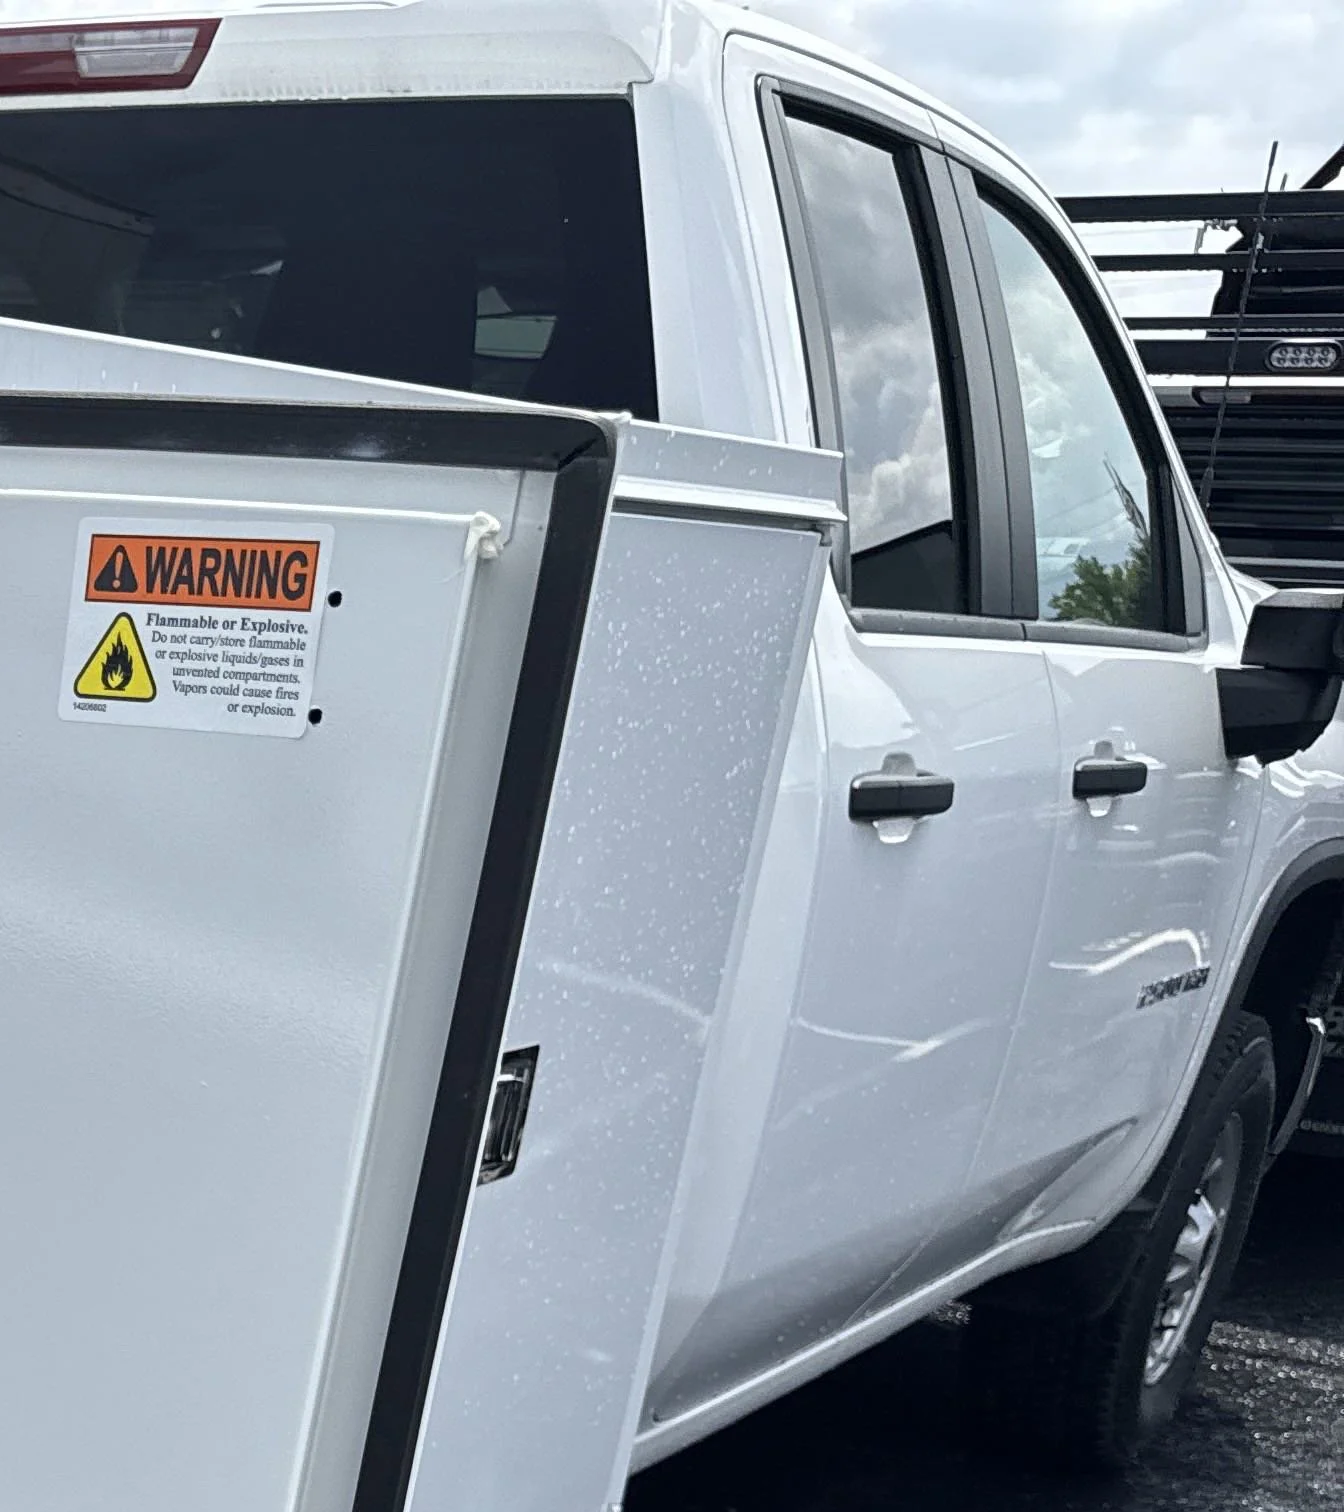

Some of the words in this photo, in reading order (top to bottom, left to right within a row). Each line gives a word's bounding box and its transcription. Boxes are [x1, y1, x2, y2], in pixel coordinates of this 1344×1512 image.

[145, 546, 309, 601] WARNING
[146, 612, 219, 630] Flammable
[222, 618, 237, 631] or
[240, 617, 309, 635] Explosive.
[151, 630, 168, 643] Do
[170, 632, 187, 644] not
[189, 634, 246, 648] carry/store
[249, 635, 307, 651] flammable
[155, 650, 168, 660] or
[168, 649, 219, 664] explosive
[221, 650, 290, 668] liquids/gases
[293, 654, 305, 668] in
[172, 666, 220, 679] unvented
[222, 670, 301, 684] compartments.
[172, 680, 207, 696] Vapors
[210, 684, 240, 697] could
[242, 688, 273, 698] cause
[275, 687, 300, 700] fires
[227, 703, 239, 713] or
[242, 702, 296, 717] explosion.
